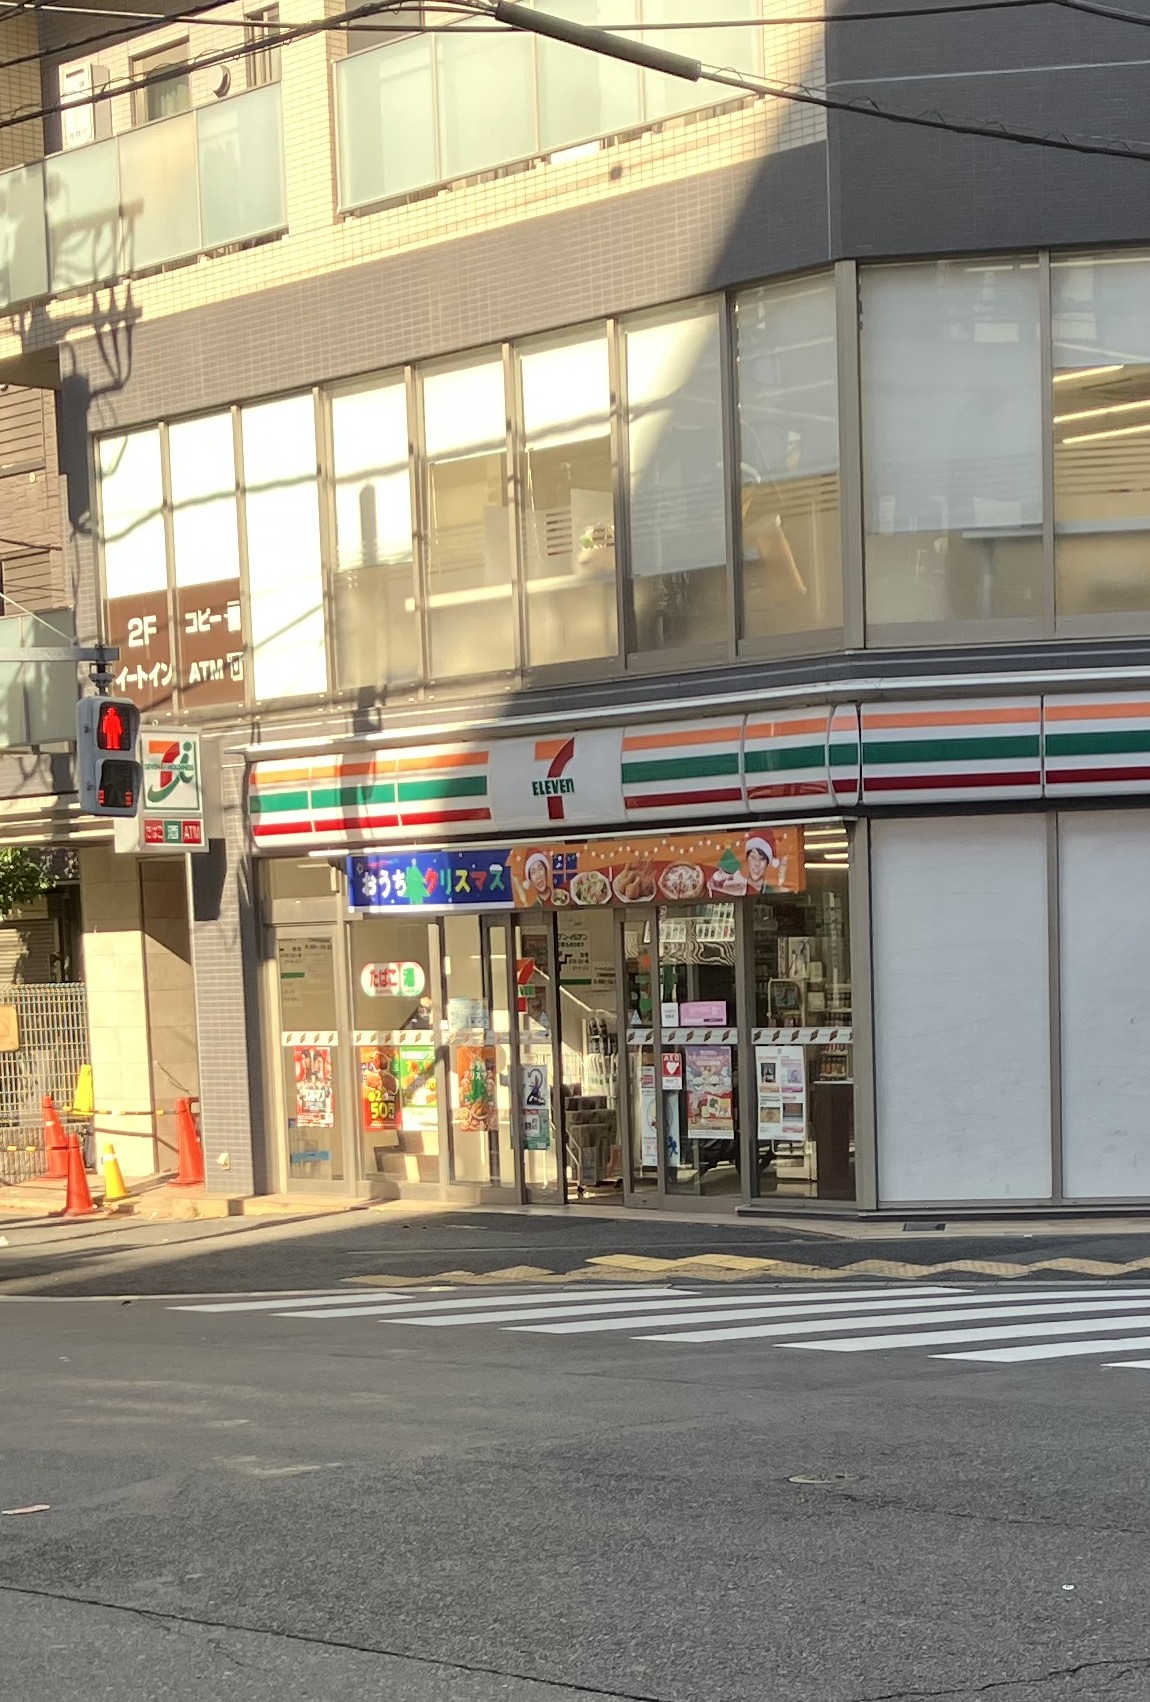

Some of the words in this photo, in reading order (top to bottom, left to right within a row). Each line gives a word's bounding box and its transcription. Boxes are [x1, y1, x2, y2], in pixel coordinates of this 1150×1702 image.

[127, 615, 157, 648] 2F
[184, 607, 222, 634] コピー
[115, 661, 173, 692] イートイン
[188, 658, 224, 684] ATM
[370, 967, 397, 988] たばこ
[663, 1054, 680, 1062] AED
